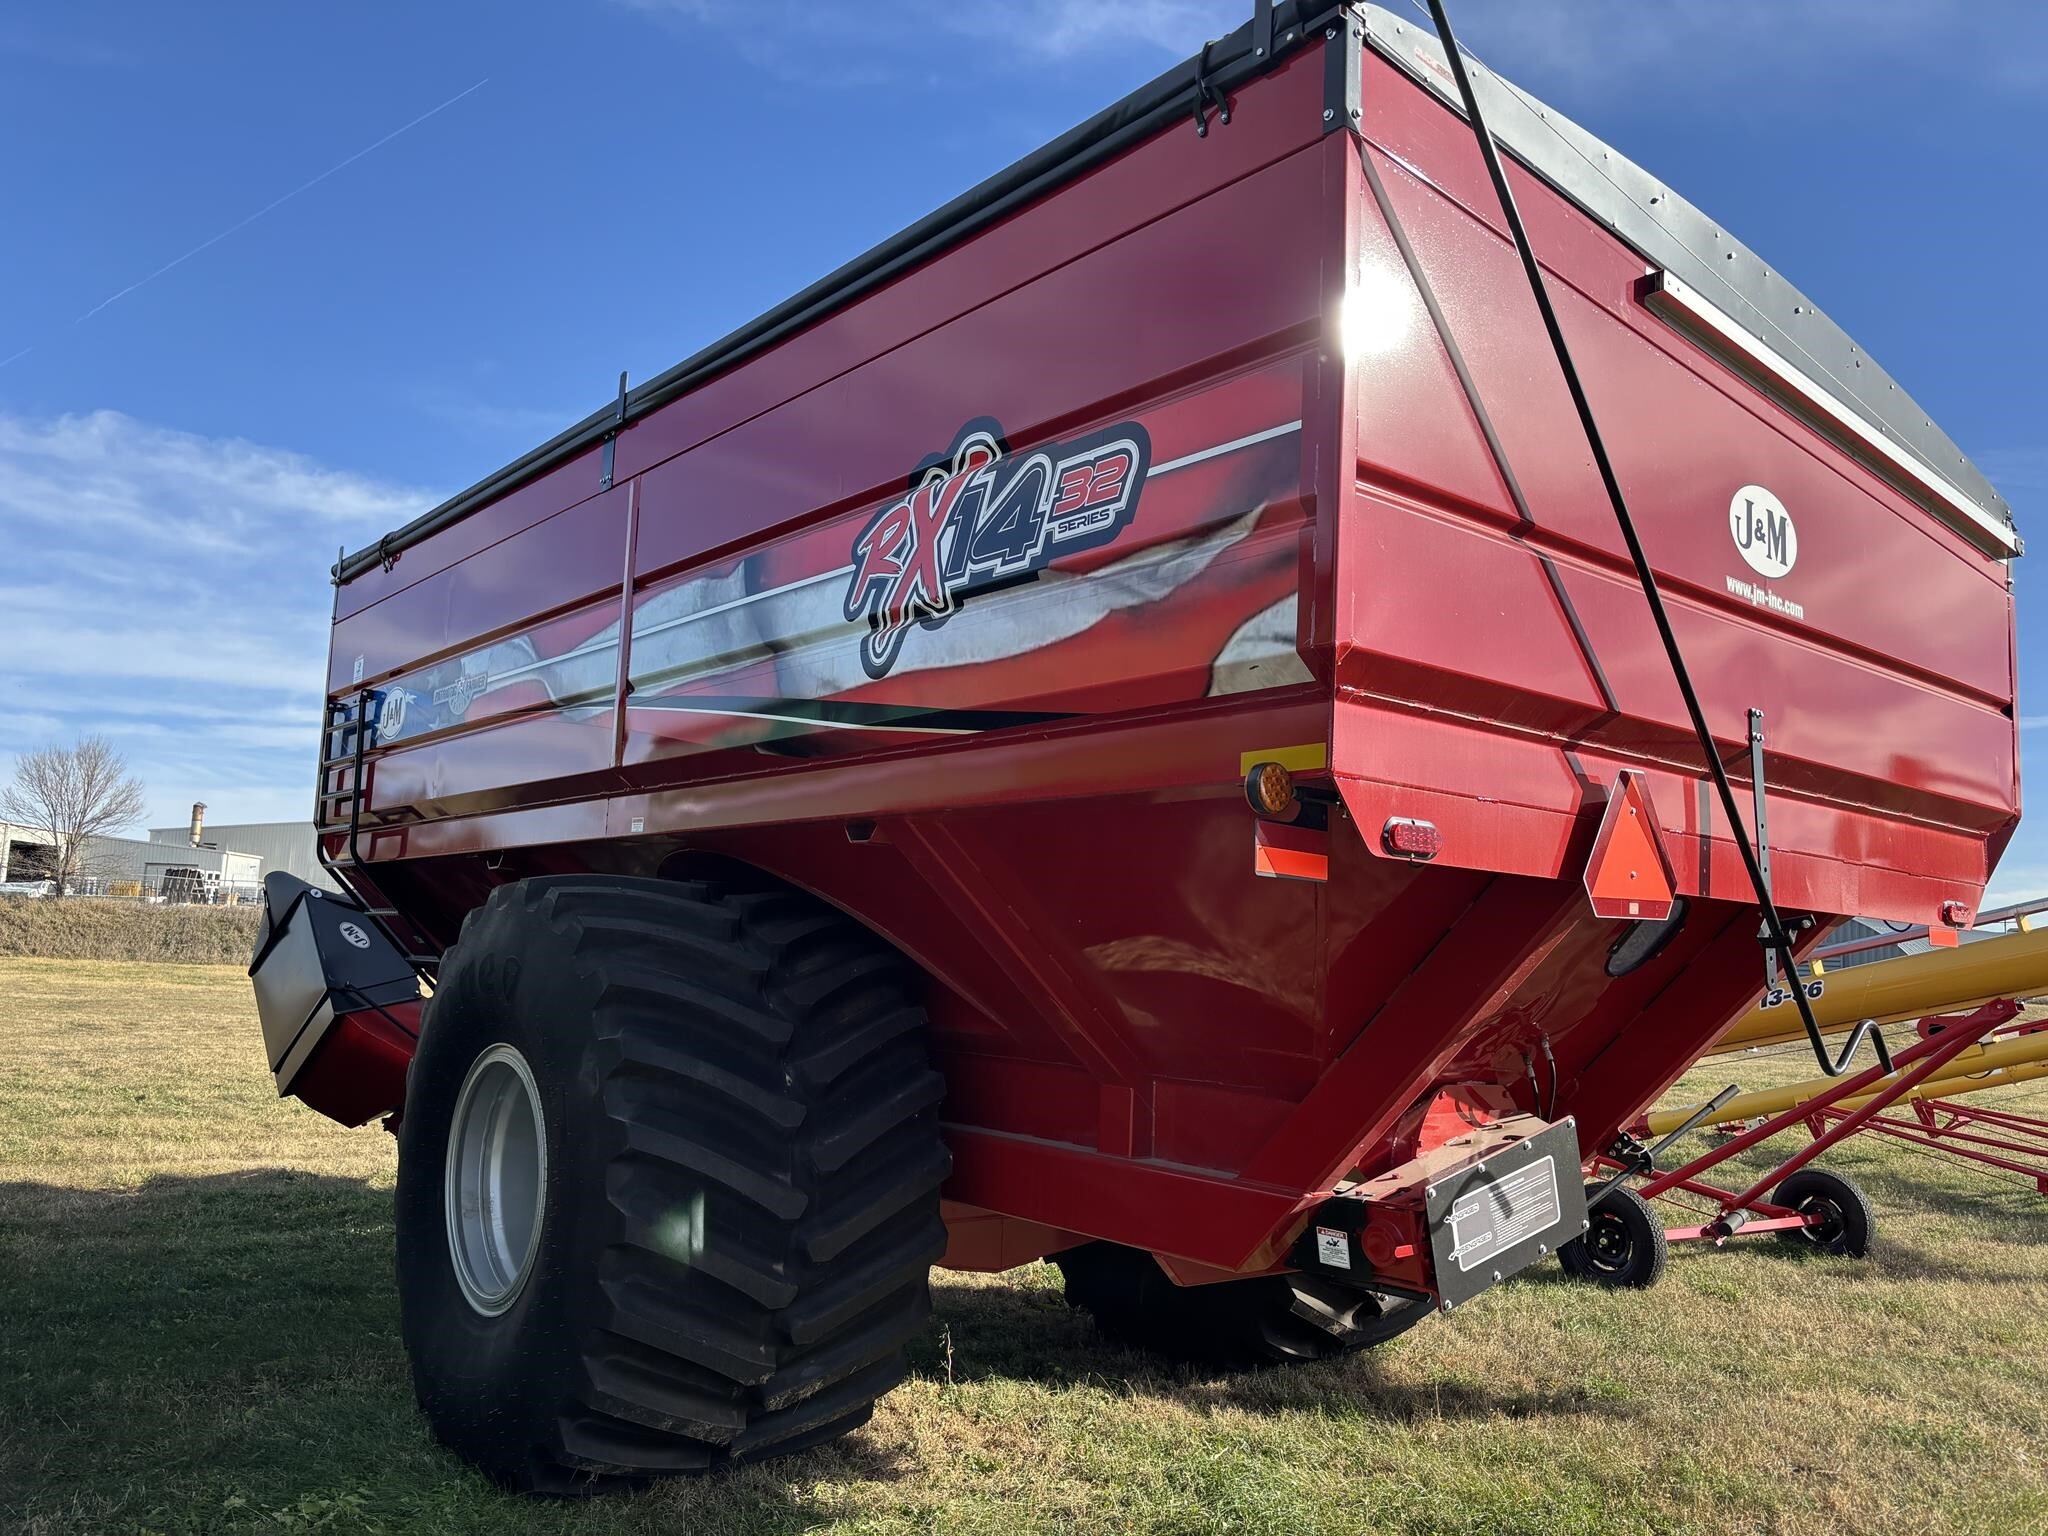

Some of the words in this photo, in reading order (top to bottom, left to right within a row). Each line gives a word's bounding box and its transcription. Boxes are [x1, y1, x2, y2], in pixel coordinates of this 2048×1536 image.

[1053, 455, 1128, 516] 32
[1058, 508, 1110, 534] SERIES
[1735, 498, 1788, 567] J&M
[1726, 575, 1804, 620] www.jm-inc.com
[383, 696, 403, 730] J&M
[343, 925, 367, 945] J&M
